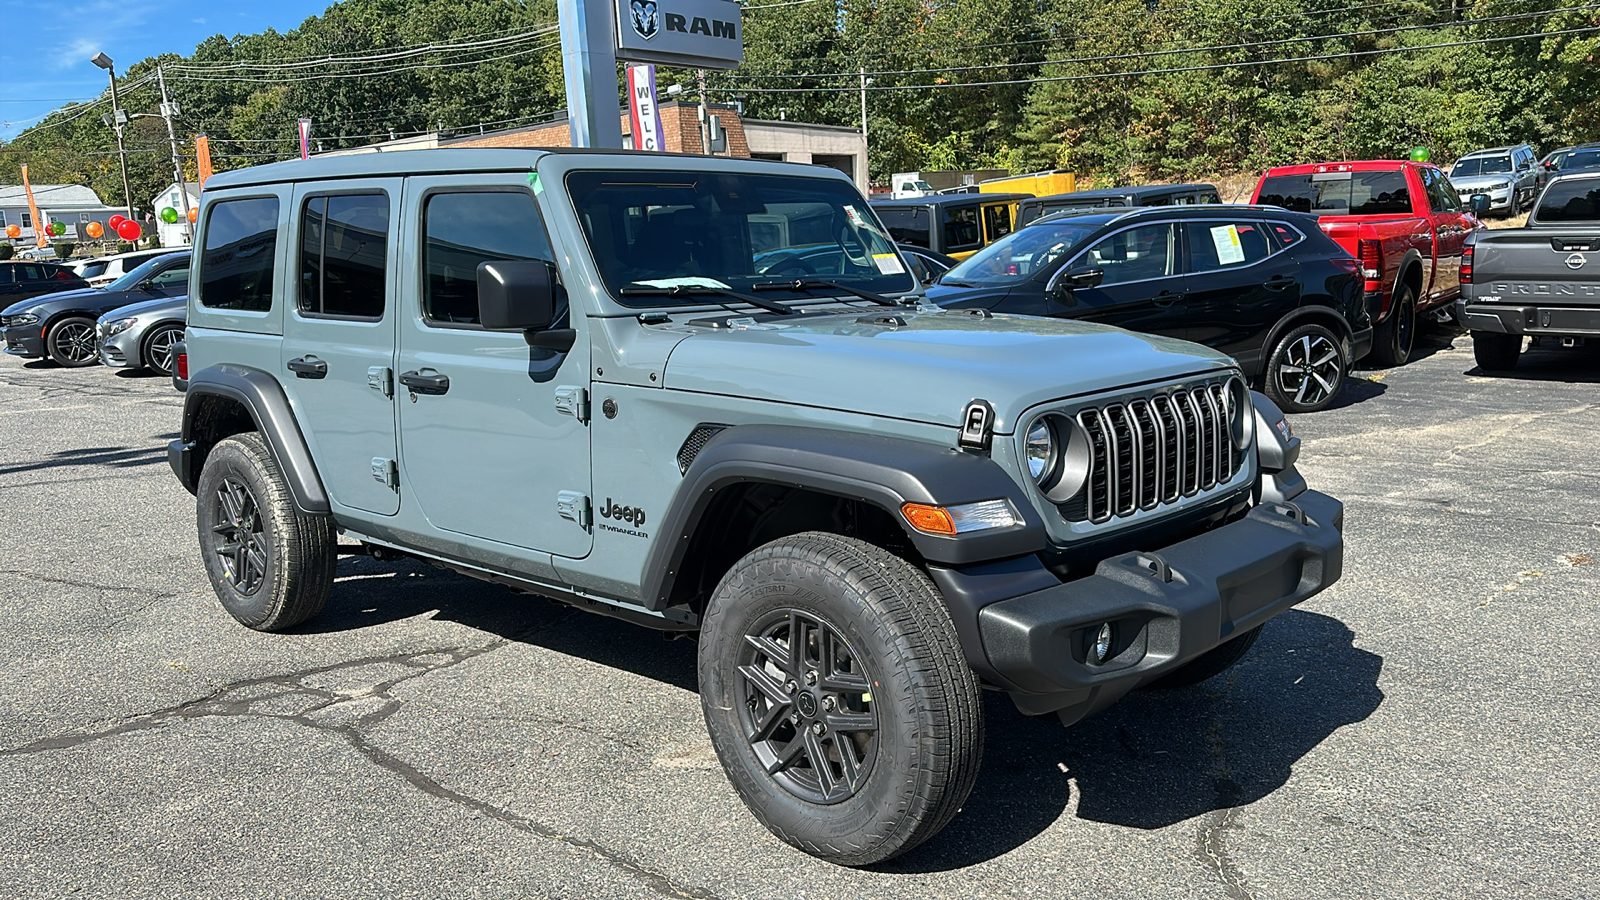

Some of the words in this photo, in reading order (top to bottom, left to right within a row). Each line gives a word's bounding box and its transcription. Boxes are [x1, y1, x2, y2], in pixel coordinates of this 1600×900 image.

[665, 13, 736, 40] RAM
[600, 497, 646, 528] Jeep
[606, 525, 648, 539] WRANGLER
